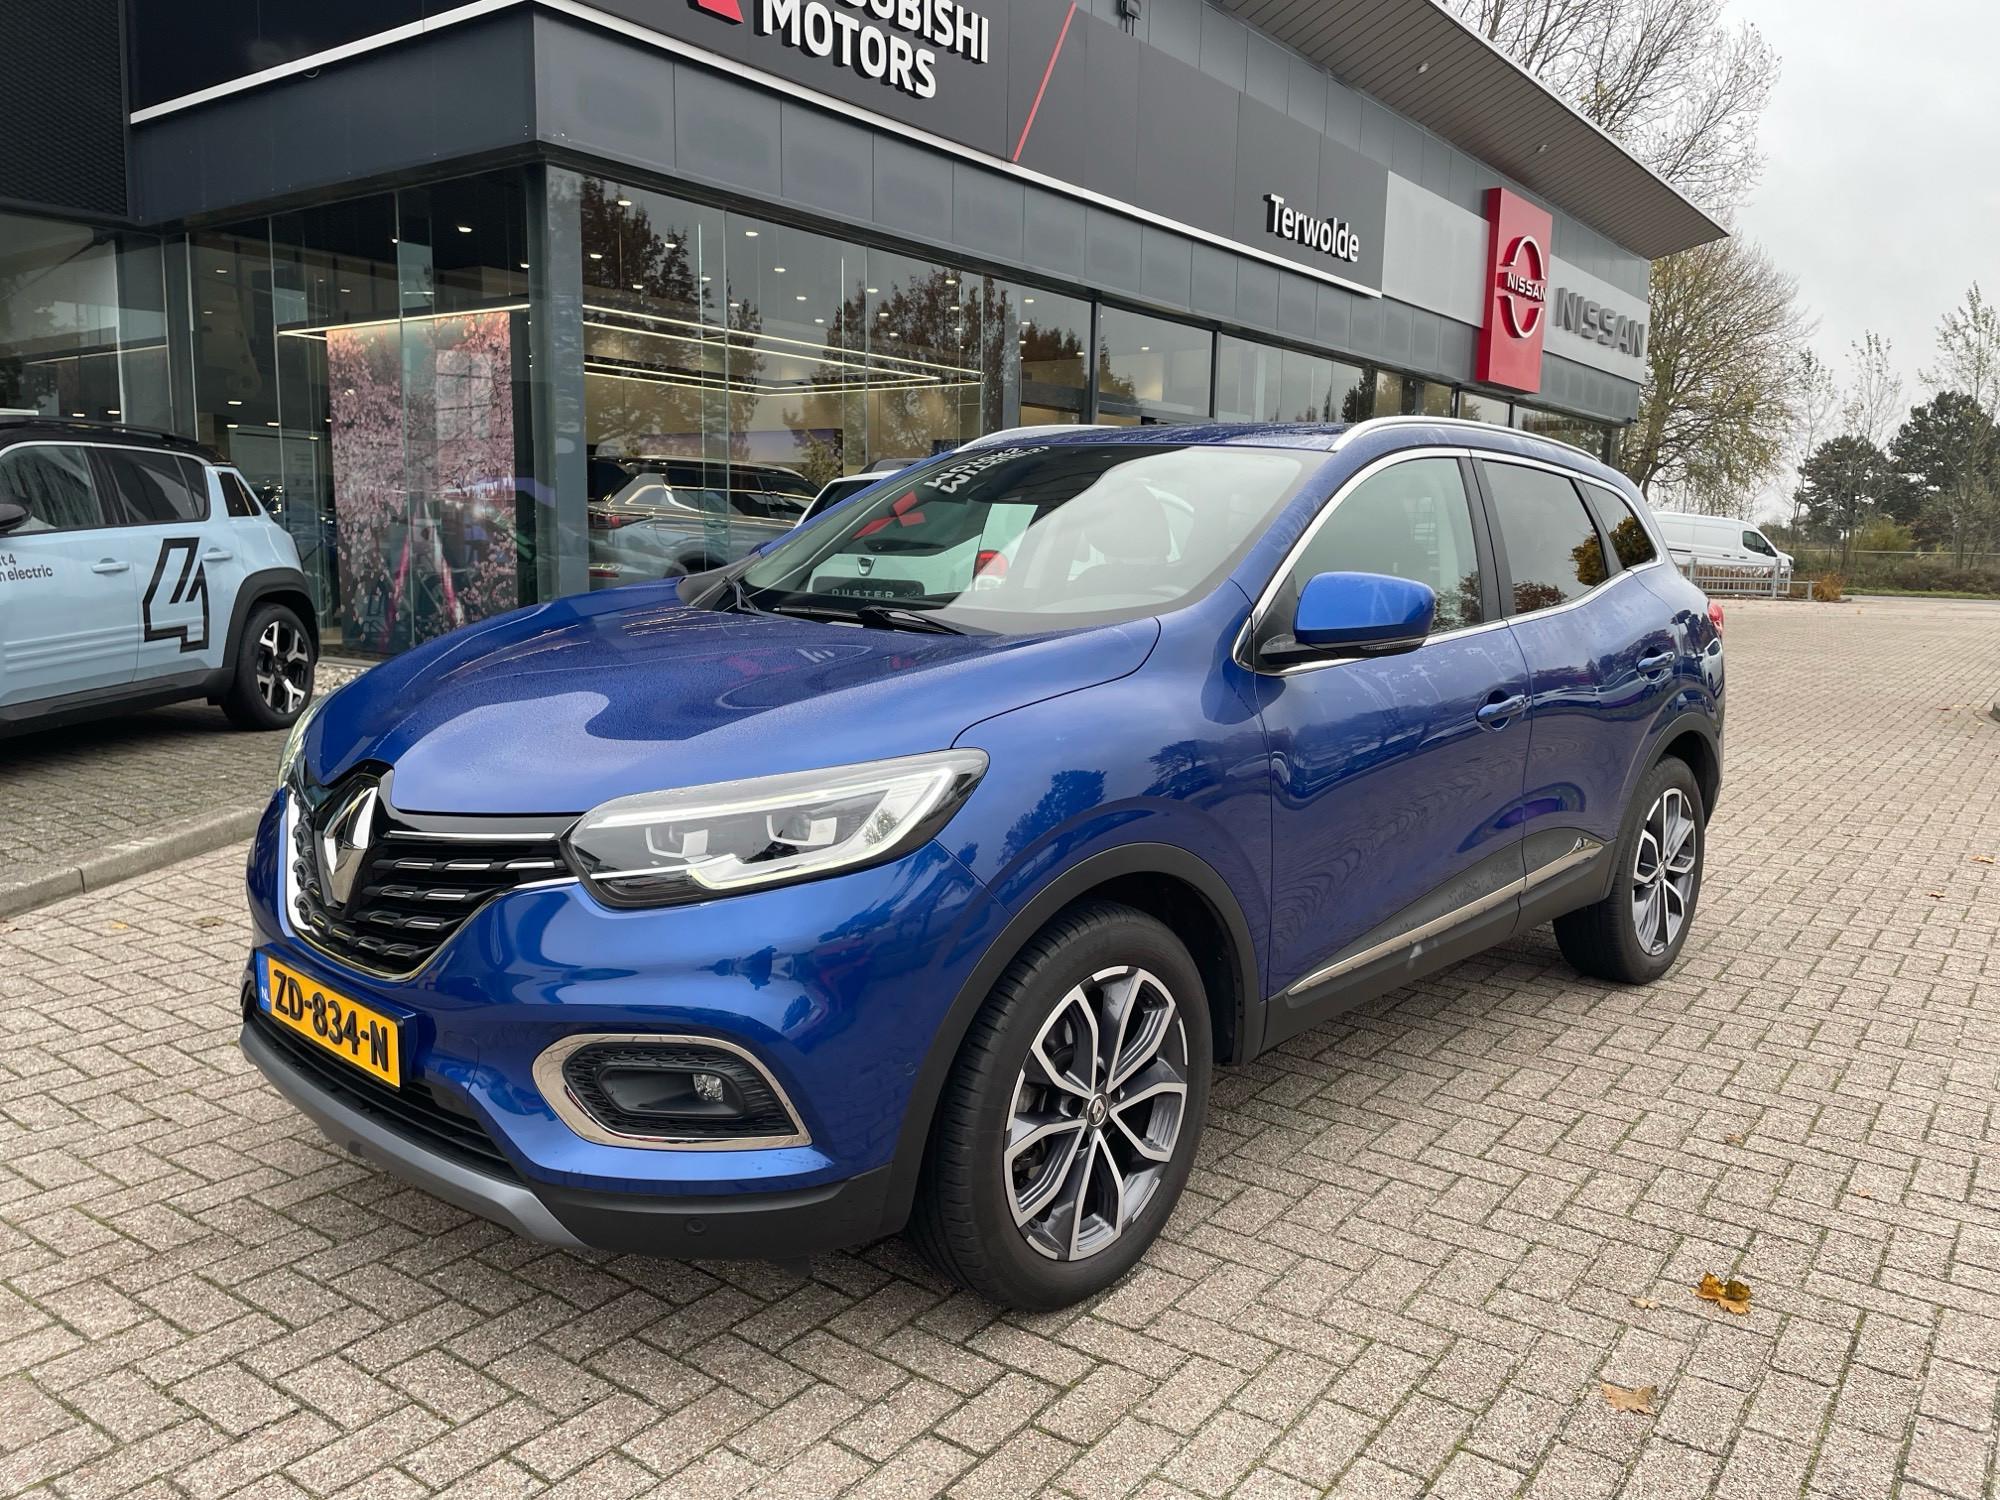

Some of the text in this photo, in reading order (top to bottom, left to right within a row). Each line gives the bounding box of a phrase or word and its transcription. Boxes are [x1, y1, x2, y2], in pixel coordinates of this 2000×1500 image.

[760, 0, 937, 99] MOTORS
[1266, 193, 1359, 262] Terwolde
[1507, 272, 1546, 301] NISSAN
[1552, 287, 1645, 357] NISSAN
[7, 564, 53, 581] electric
[8, 552, 17, 566] 4
[832, 588, 895, 599] DUSTER
[261, 985, 271, 1002] NL
[274, 969, 389, 1072] ZD-834-N
